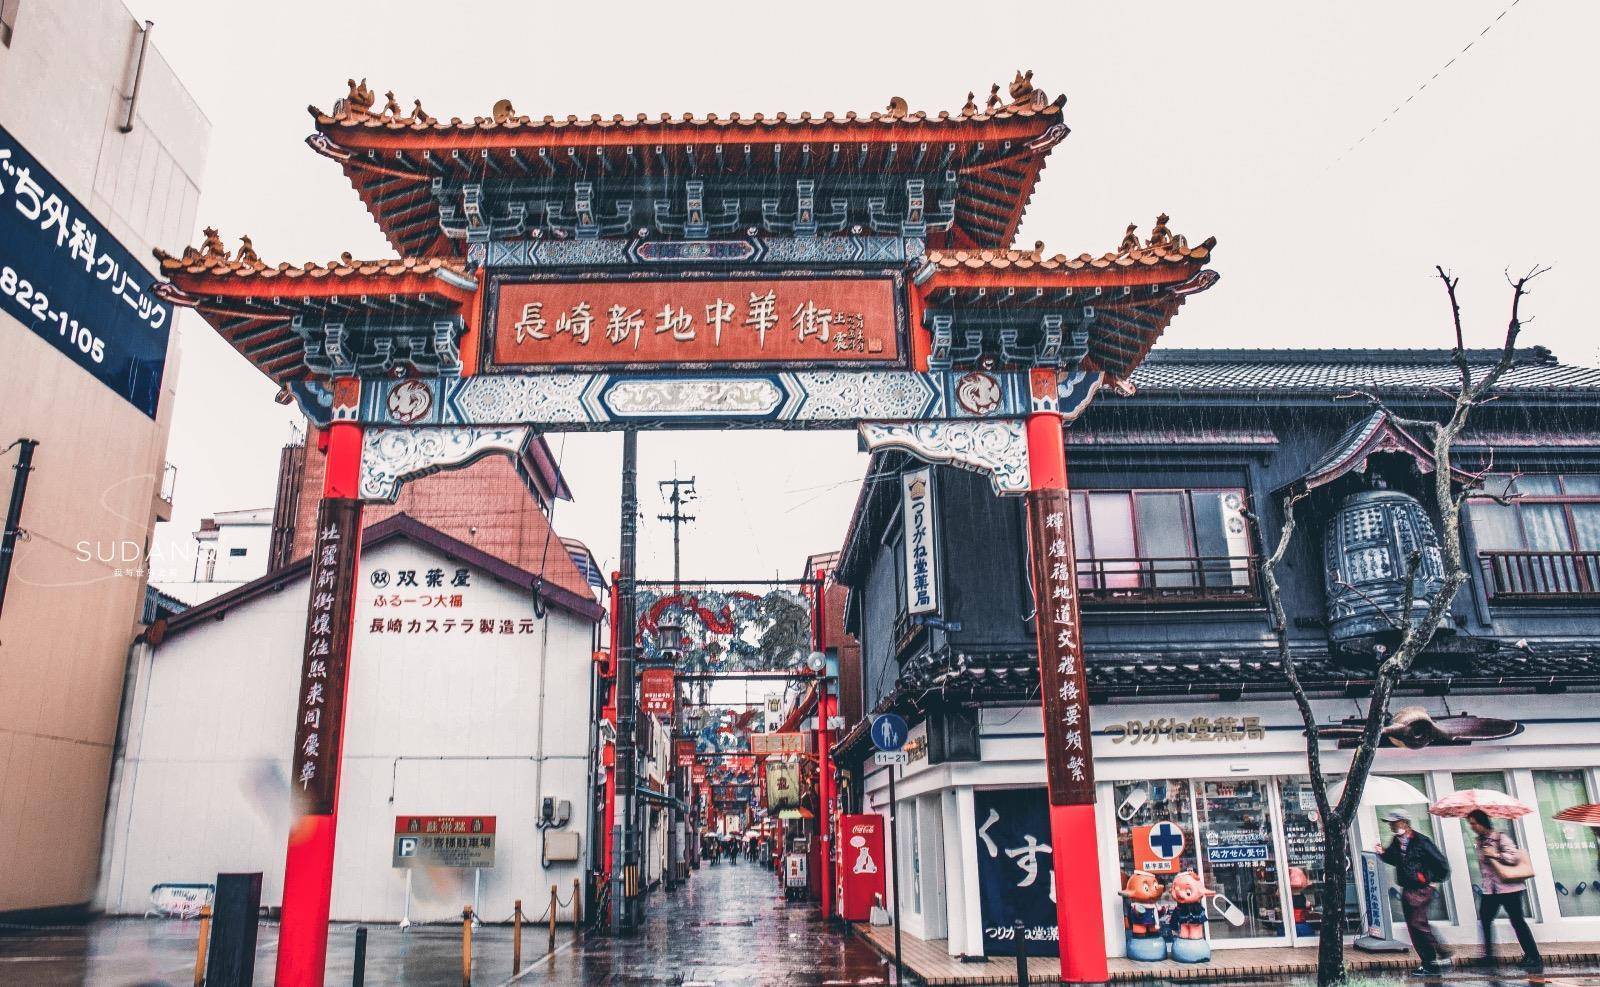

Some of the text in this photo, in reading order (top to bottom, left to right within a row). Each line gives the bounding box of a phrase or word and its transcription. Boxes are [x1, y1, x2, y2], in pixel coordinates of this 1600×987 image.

[0, 266, 105, 363] 822-1105
[514, 290, 833, 350] 長崎新地中華街
[911, 501, 930, 607] つりがね堂薬局
[373, 594, 463, 608] ふるーつ大福
[369, 618, 534, 635] 長崎カステラ製造元
[1104, 716, 1266, 745] つりがね堂薬局
[401, 839, 416, 856] P
[1210, 848, 1266, 859] 処方せん受付
